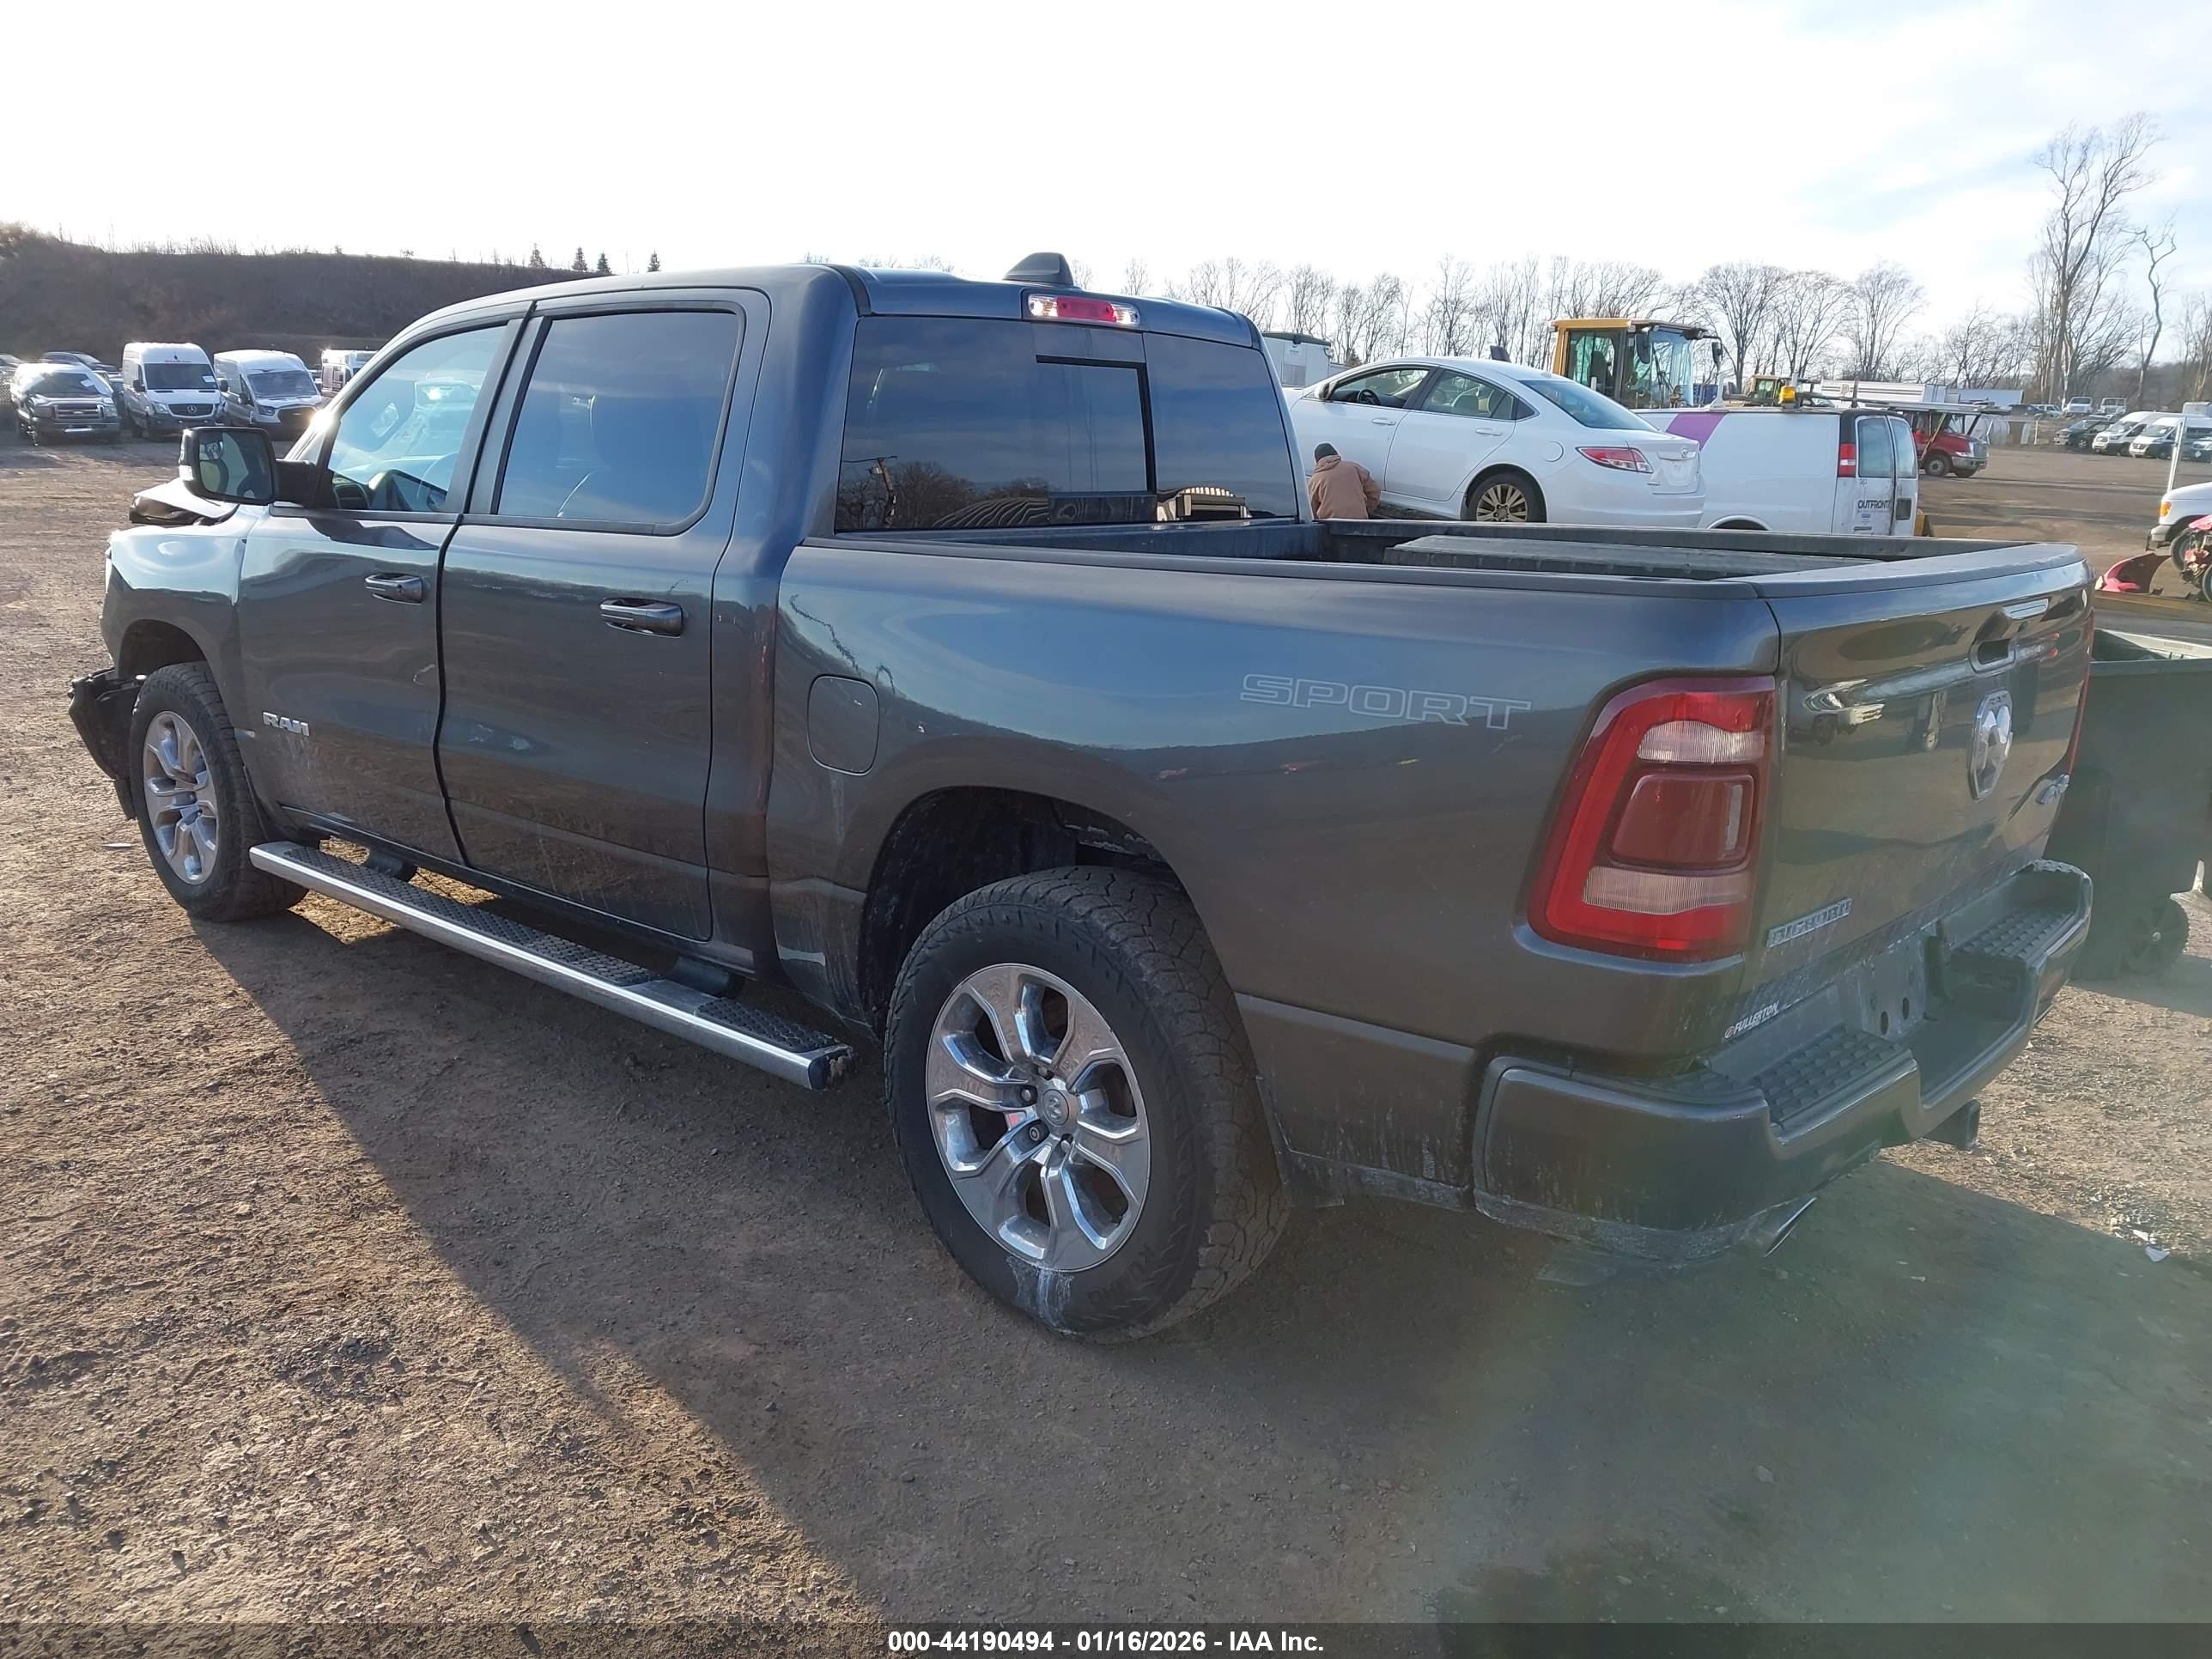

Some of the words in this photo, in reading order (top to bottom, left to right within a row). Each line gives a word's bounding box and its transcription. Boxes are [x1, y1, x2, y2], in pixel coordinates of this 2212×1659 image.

[1240, 674, 1532, 729] SPORT
[263, 712, 309, 736] RAM
[1734, 1000, 1780, 1034] FULLERTON
